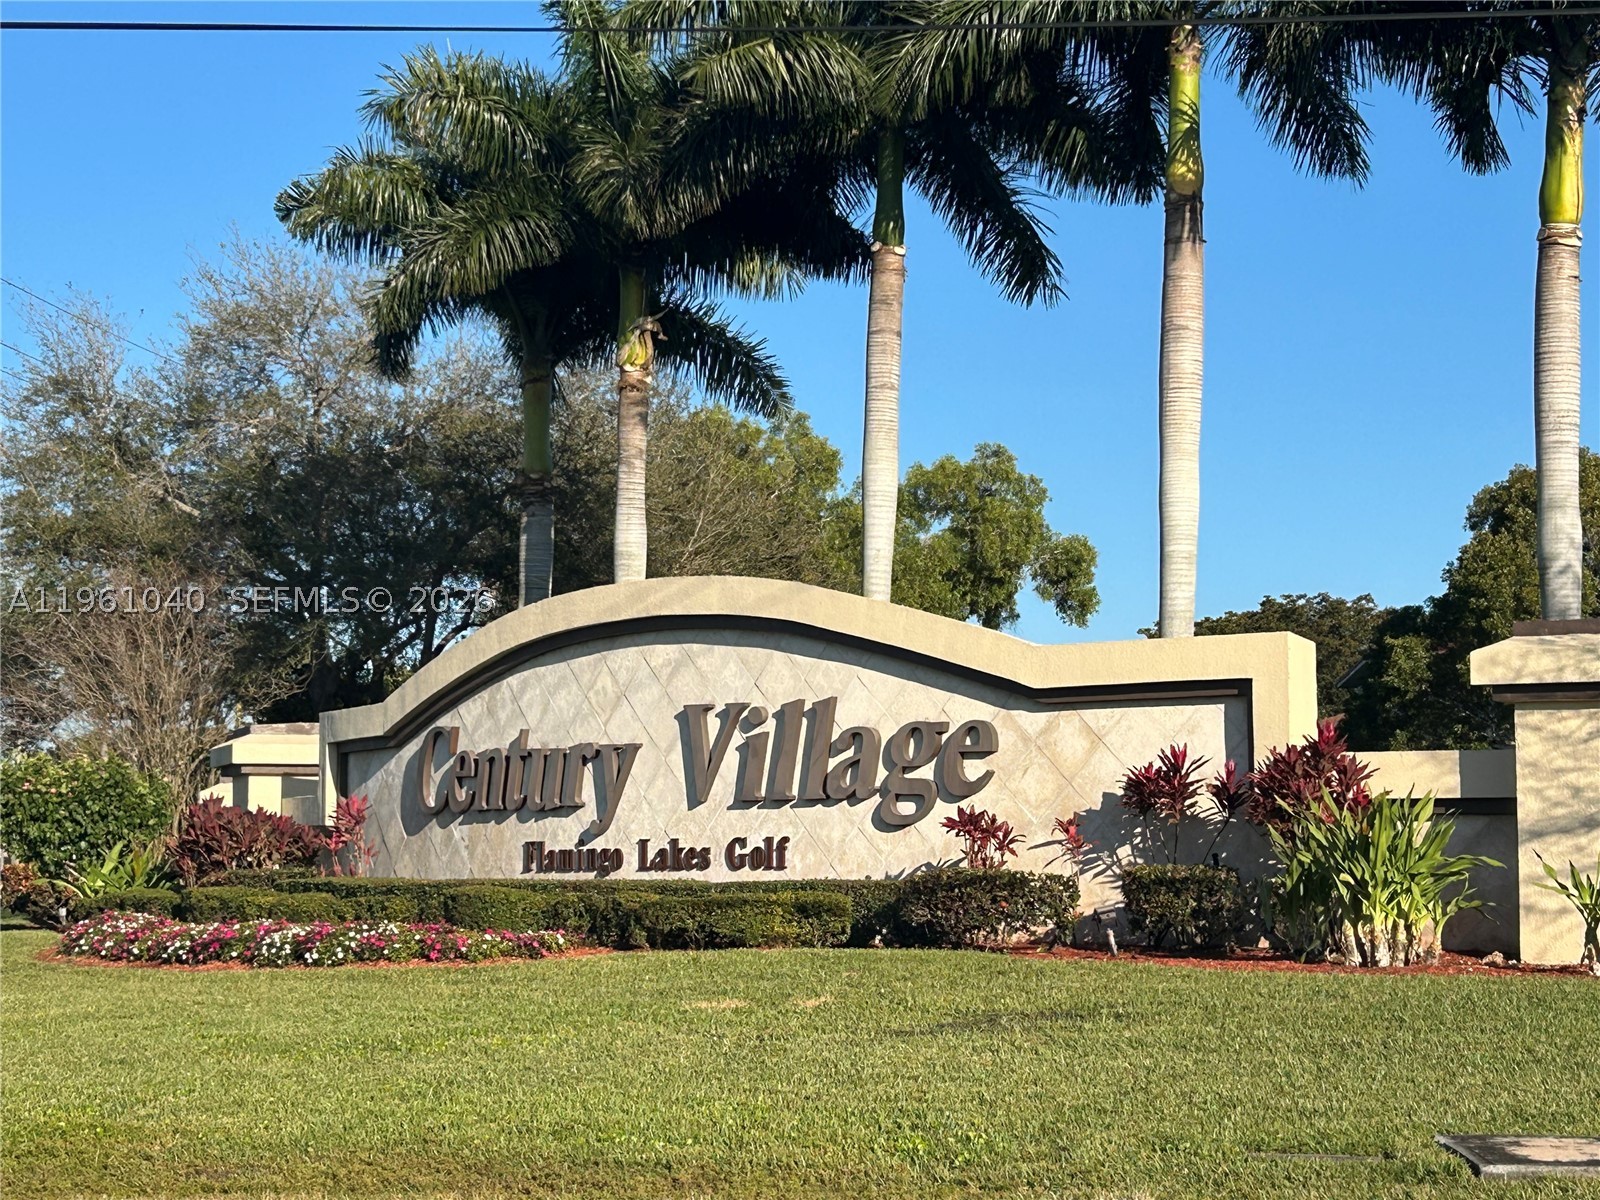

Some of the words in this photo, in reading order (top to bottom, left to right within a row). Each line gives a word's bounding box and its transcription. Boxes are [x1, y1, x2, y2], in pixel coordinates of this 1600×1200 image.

[418, 725, 643, 836] Century
[674, 696, 999, 827] Village
[522, 839, 623, 878] Flamingo
[637, 838, 711, 872] Lakes
[725, 836, 790, 871] Golf
